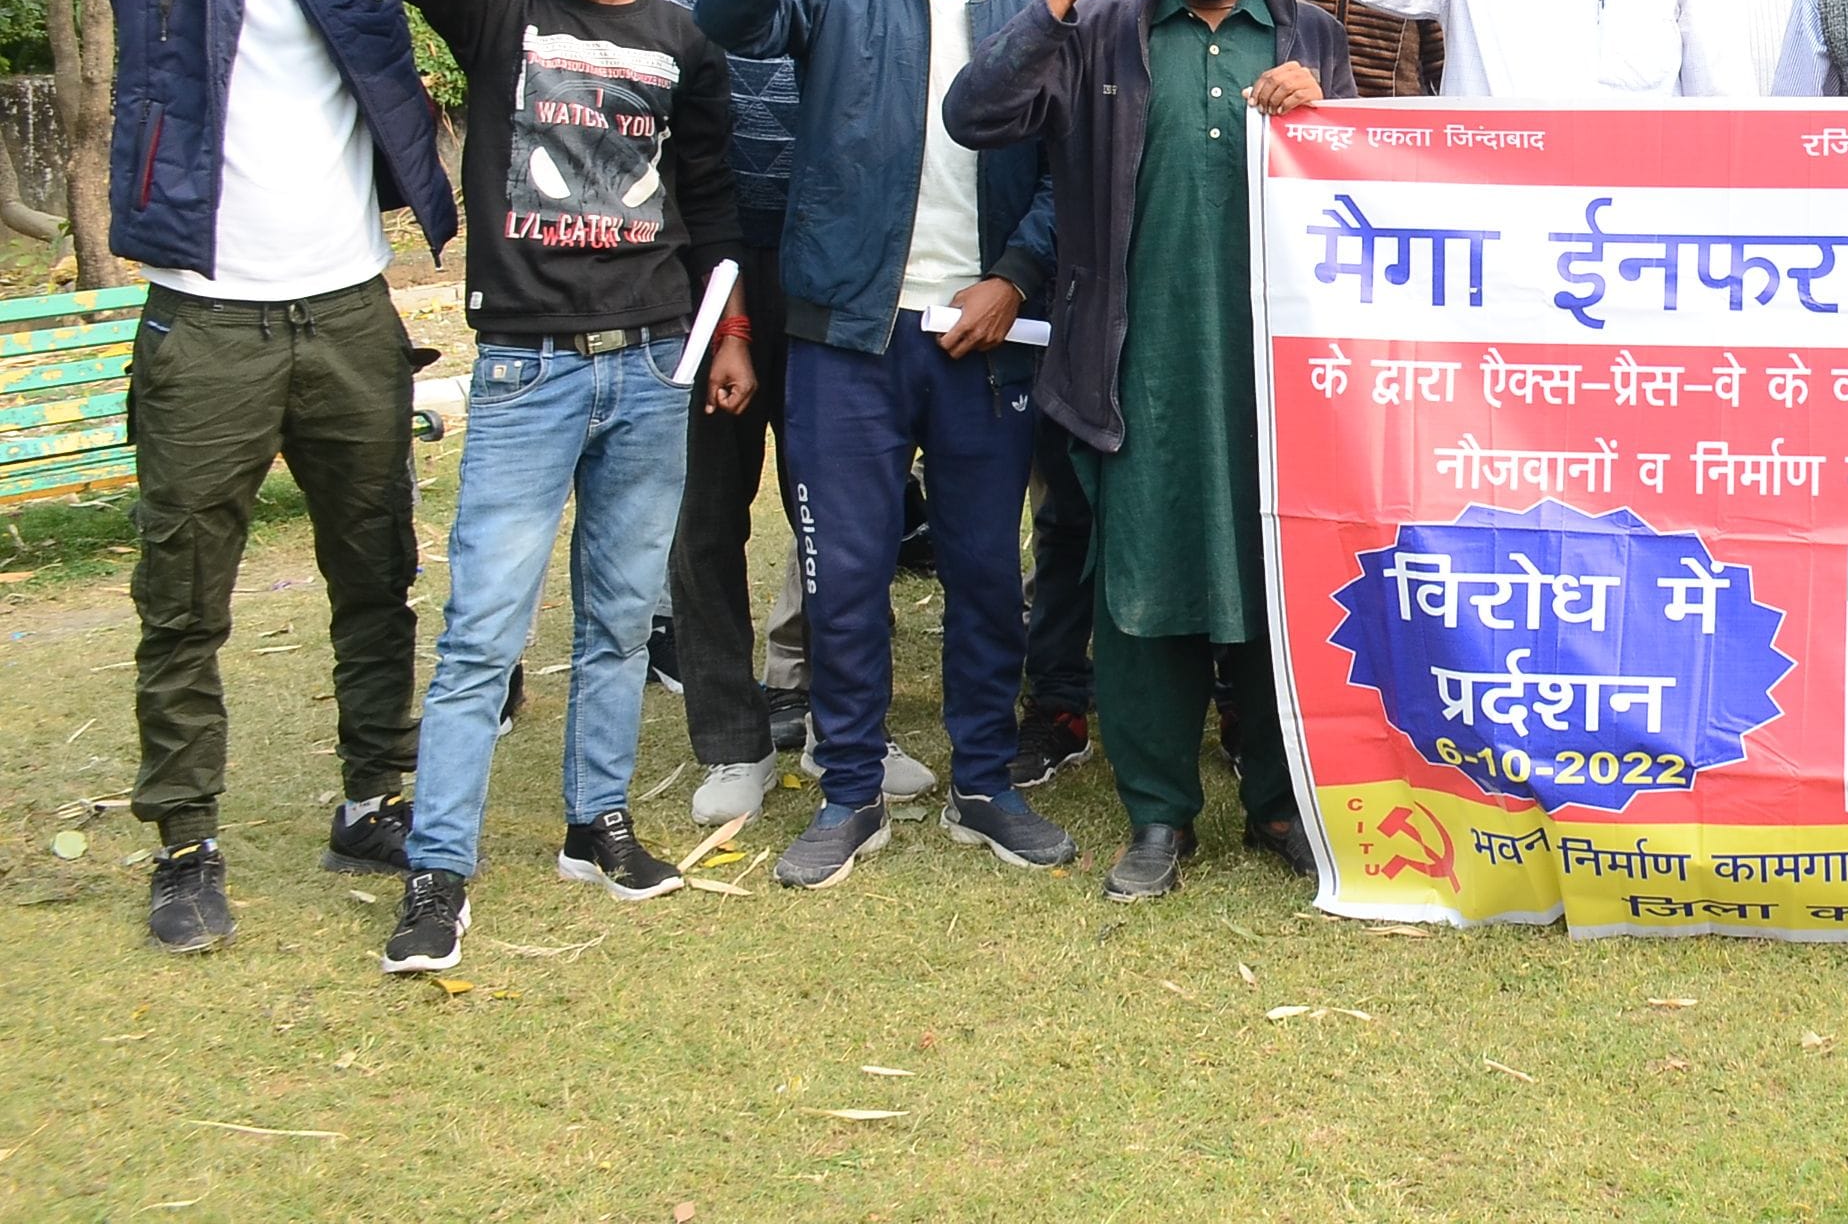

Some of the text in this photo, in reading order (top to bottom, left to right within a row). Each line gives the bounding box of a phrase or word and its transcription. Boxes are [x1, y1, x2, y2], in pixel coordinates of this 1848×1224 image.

[535, 101, 655, 137] WATCH YOU
[1285, 123, 1355, 151] मजदूर
[1366, 126, 1433, 148] एकता
[1307, 194, 1501, 307] मैगा
[1309, 343, 1352, 399] के
[1371, 359, 1462, 405] द्वारा
[1766, 353, 1812, 409] के
[1433, 433, 1619, 494] नौजवानों
[1637, 453, 1671, 494] व
[1690, 438, 1827, 498] निर्माण
[797, 482, 818, 594] adidas
[1383, 552, 1731, 634] विरोध में
[1434, 737, 1687, 786] 6-10-2022
[1470, 827, 1551, 865] भवन
[1556, 836, 1692, 881] निर्माण
[1621, 894, 1780, 919] जिला
